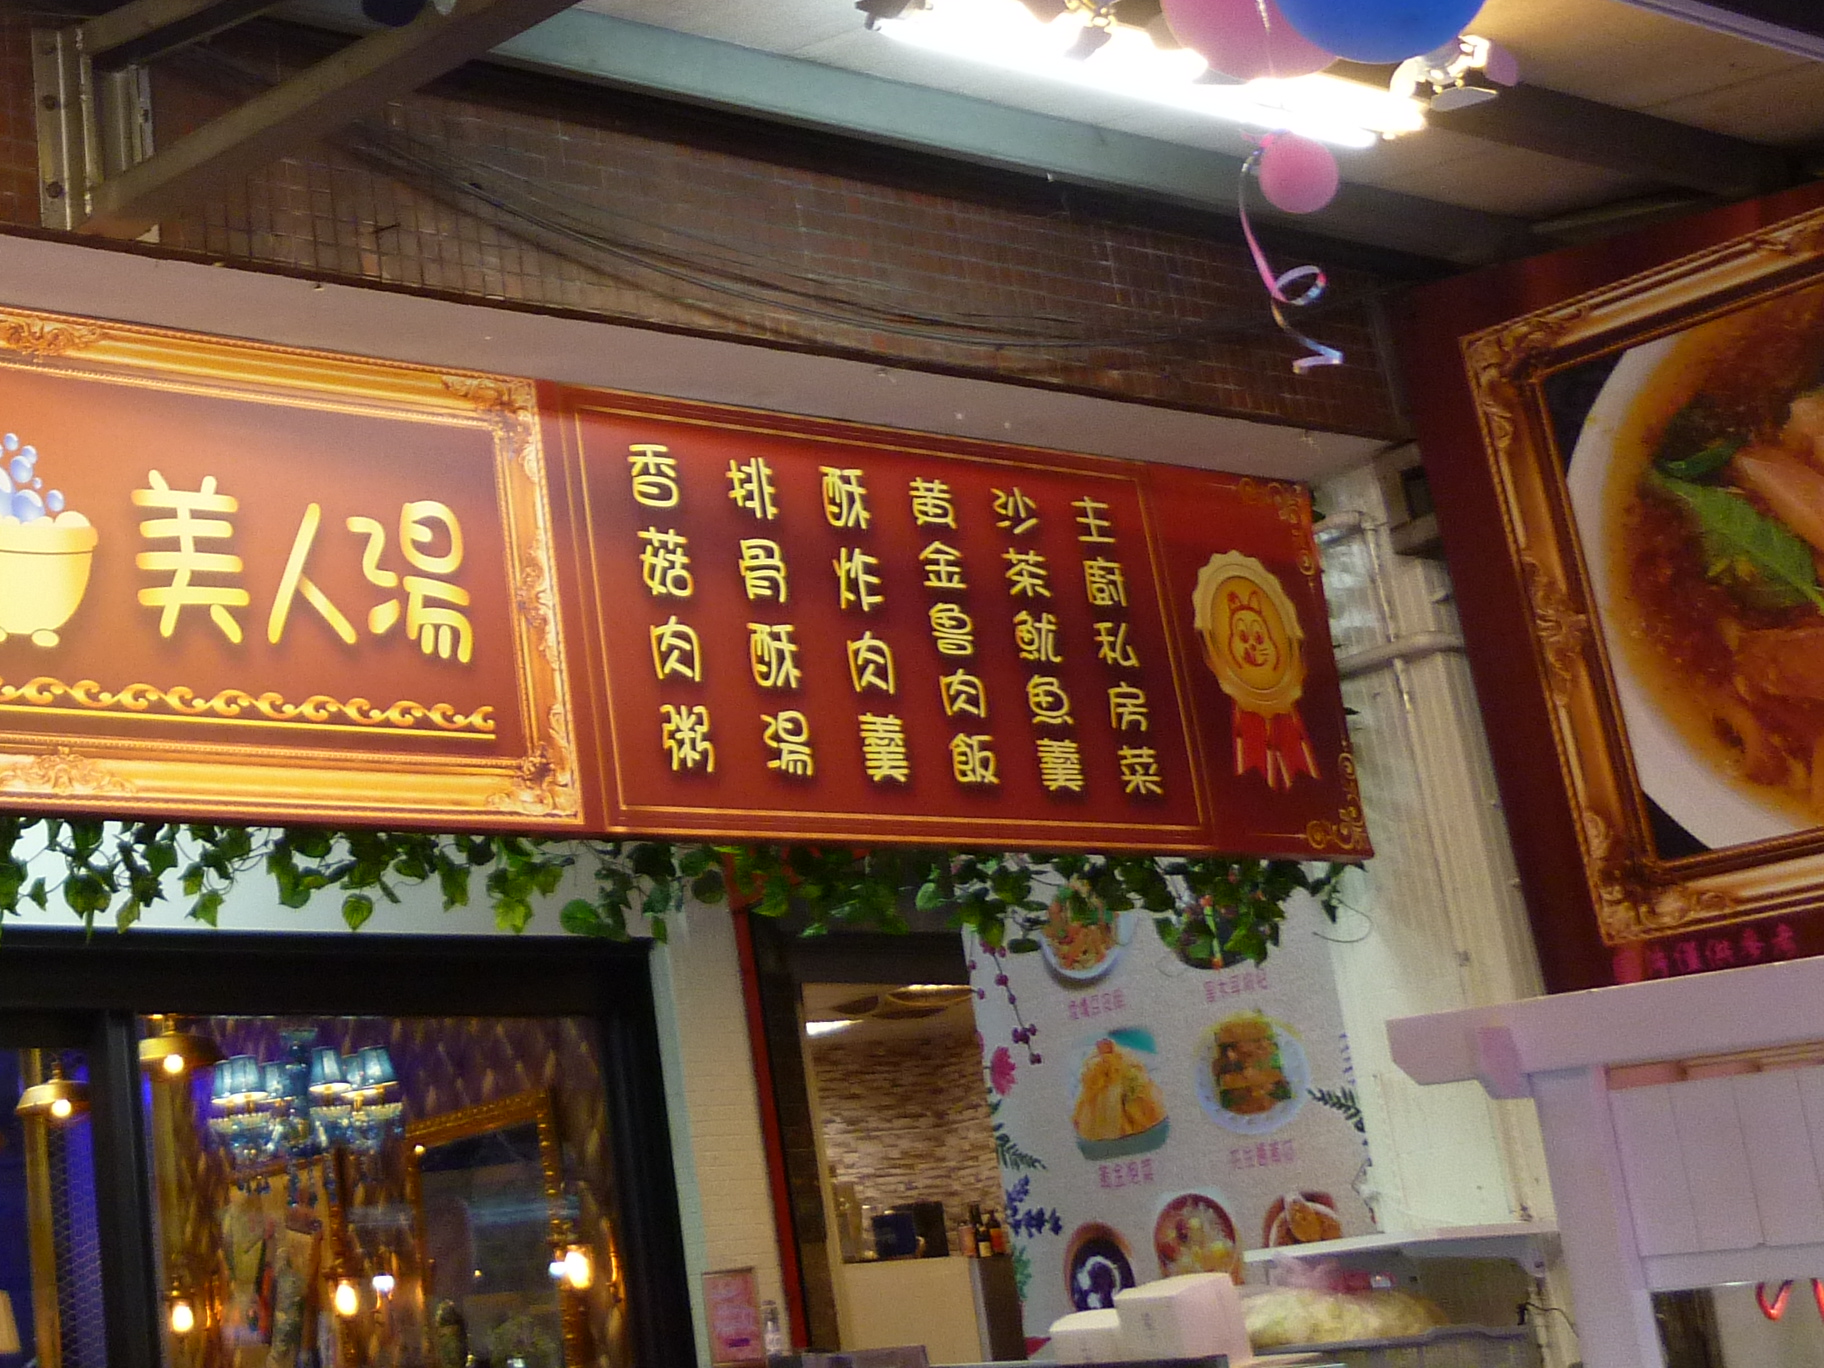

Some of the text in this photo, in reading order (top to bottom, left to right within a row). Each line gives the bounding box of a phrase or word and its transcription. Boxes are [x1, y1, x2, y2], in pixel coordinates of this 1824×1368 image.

[129, 468, 475, 664] 美人湯
[627, 443, 715, 774] 香菇肉粥
[726, 457, 815, 777] 排骨酥湯
[819, 465, 909, 783] 酥炸肉羹
[909, 477, 1001, 785] 黃金魯肉飯
[991, 486, 1084, 792] 沙茶魷魚羹
[1071, 496, 1164, 796] 主廚私房菜
